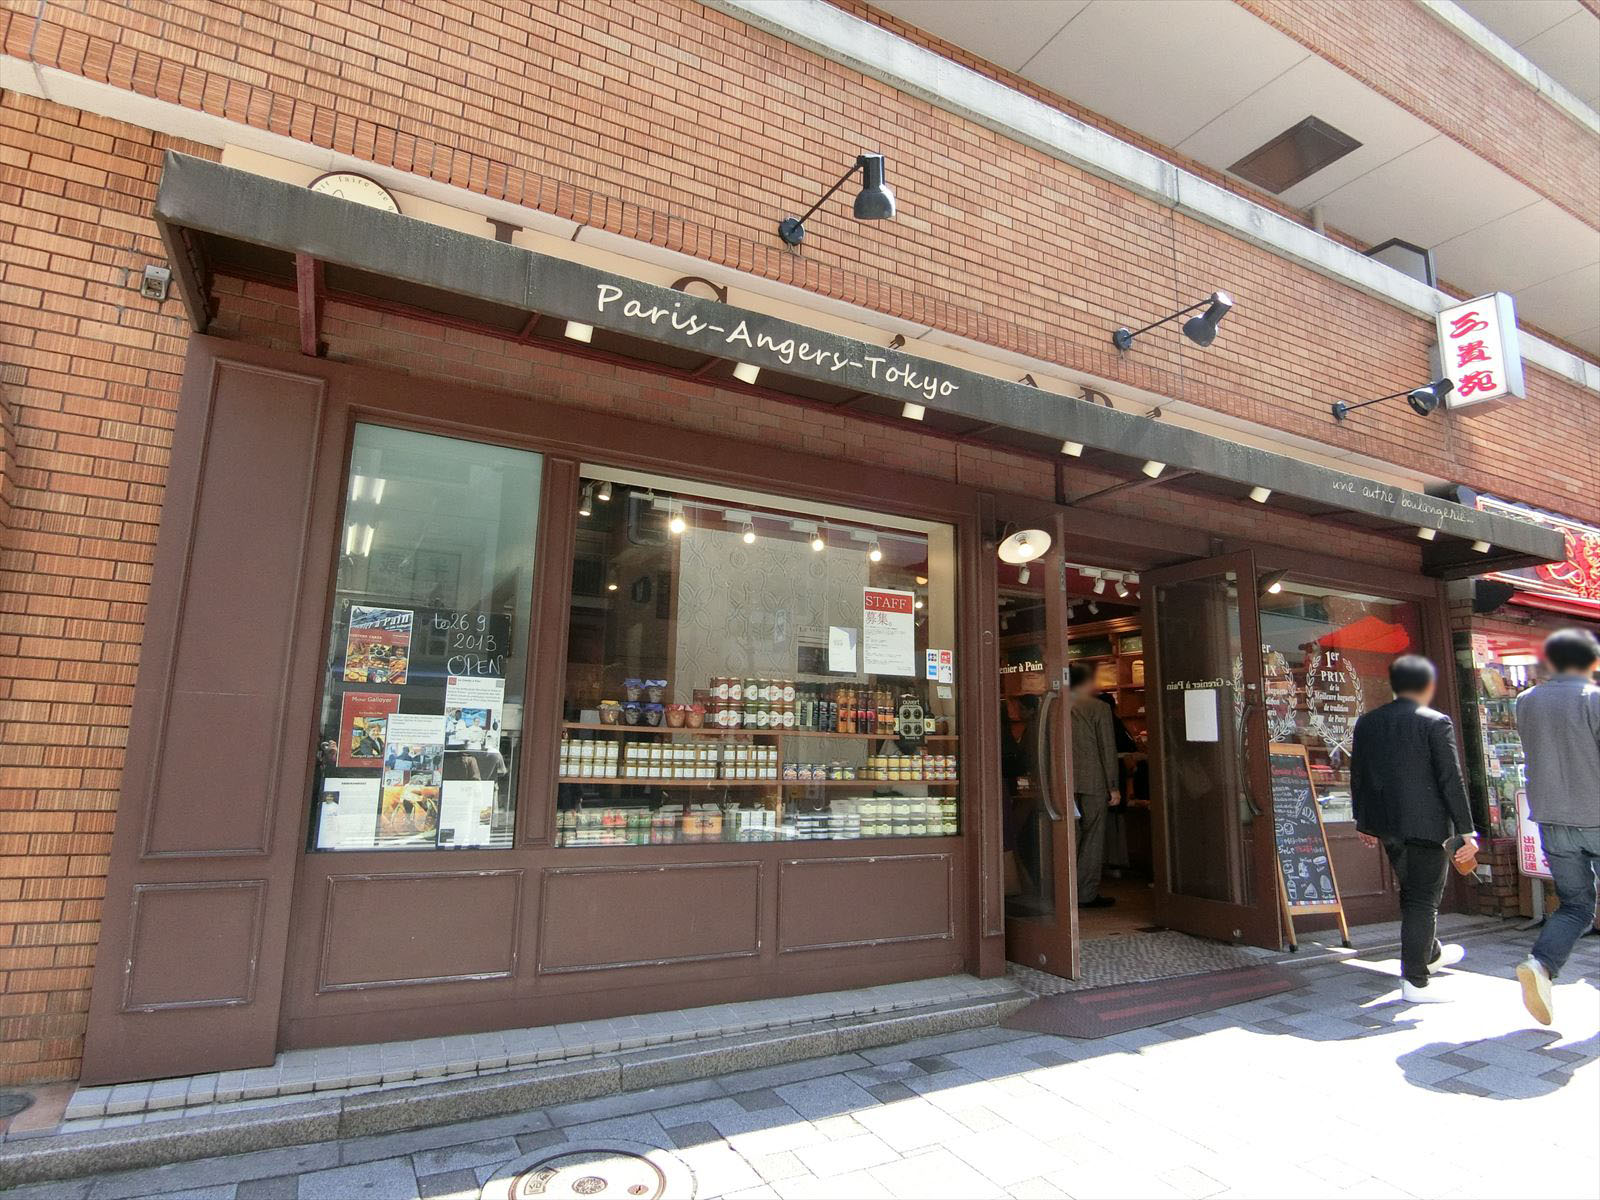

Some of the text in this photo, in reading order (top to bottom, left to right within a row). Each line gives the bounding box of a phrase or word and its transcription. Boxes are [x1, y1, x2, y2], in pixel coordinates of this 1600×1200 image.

[596, 284, 960, 401] Paris-Angers-Tokyo
[1332, 479, 1356, 493] une
[1362, 485, 1395, 504] autre
[865, 595, 907, 610] STAFF
[450, 613, 470, 631] 26
[477, 614, 486, 632] 9
[453, 632, 497, 652] 2013
[447, 653, 504, 676] OPEN
[1019, 663, 1024, 673] à
[1025, 660, 1044, 672] Pain
[1325, 650, 1340, 668] 1er
[1320, 670, 1346, 683] PRIX
